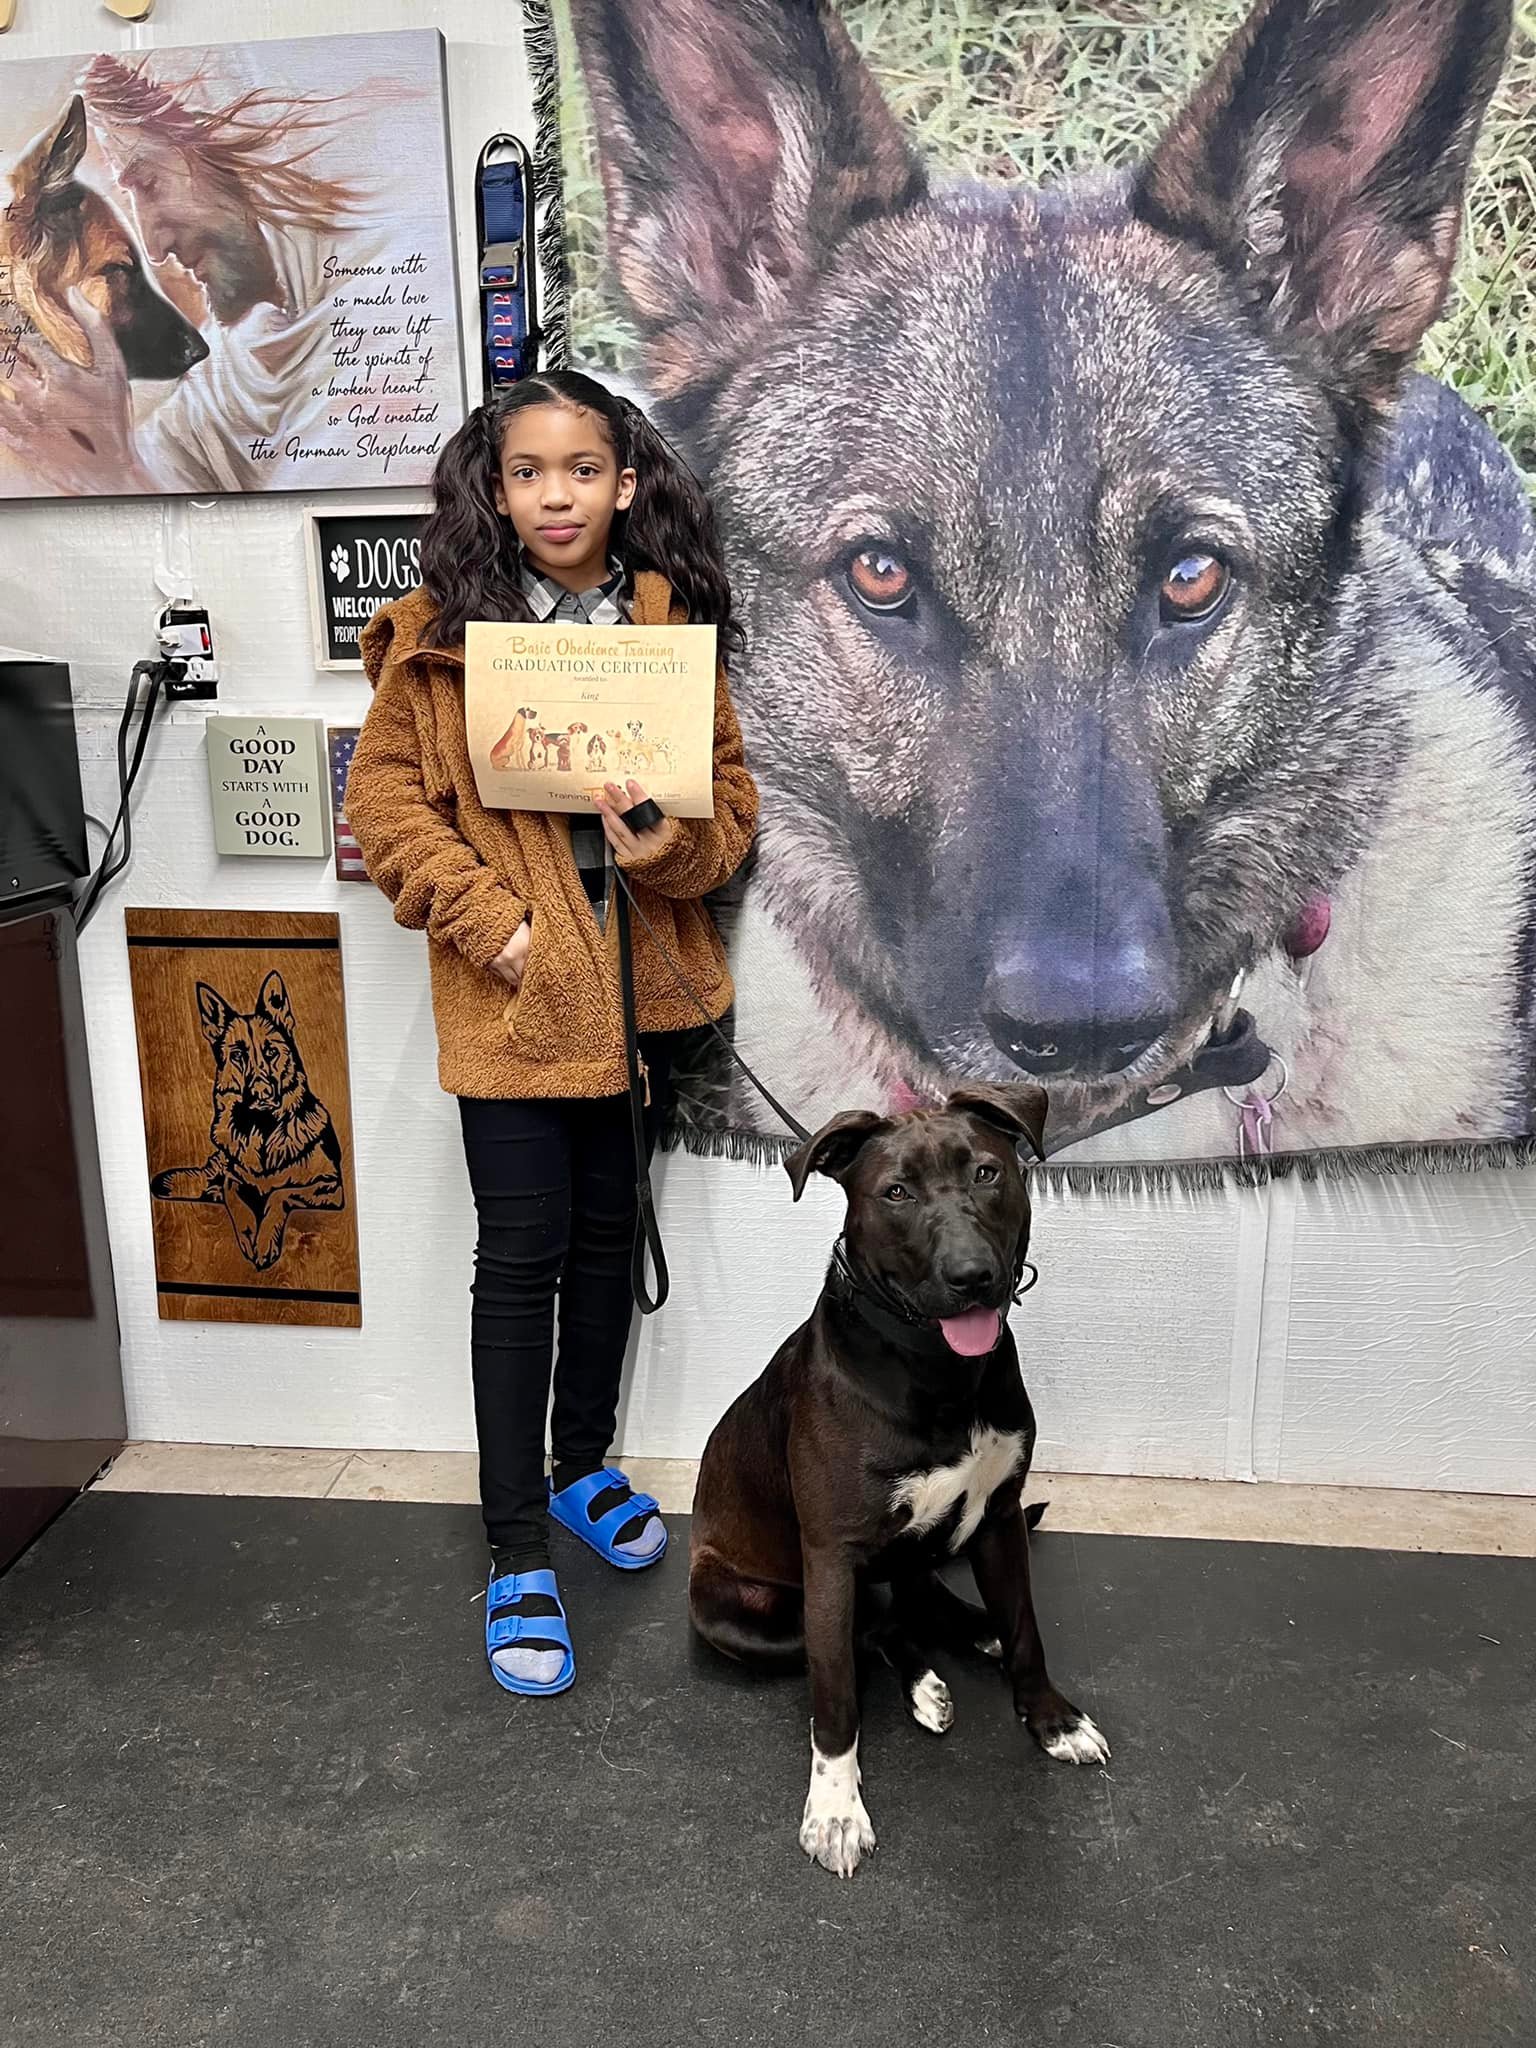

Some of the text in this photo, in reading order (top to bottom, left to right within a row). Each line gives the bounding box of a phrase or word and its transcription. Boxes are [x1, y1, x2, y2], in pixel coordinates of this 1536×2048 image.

[323, 252, 428, 279] Someone with
[332, 284, 429, 308] so much love
[330, 314, 443, 351] they can lift
[333, 345, 434, 382] the spirits of
[312, 386, 323, 397] a
[327, 376, 378, 397] broken
[327, 403, 439, 428] so God created
[248, 432, 442, 474] the German Shepherd
[354, 538, 424, 589] DOGS
[332, 596, 394, 618] WELCOM
[506, 636, 675, 664] Basic Obedience Training
[492, 658, 689, 675] GRADUATION CERTICATE
[257, 725, 266, 736] A
[229, 738, 296, 755] GOOD
[242, 759, 284, 774] DAY
[222, 780, 309, 793] STARTS WITH
[547, 791, 591, 802] Training
[262, 798, 272, 809] A
[235, 811, 301, 827] GOOD
[245, 830, 300, 846] DOG.
